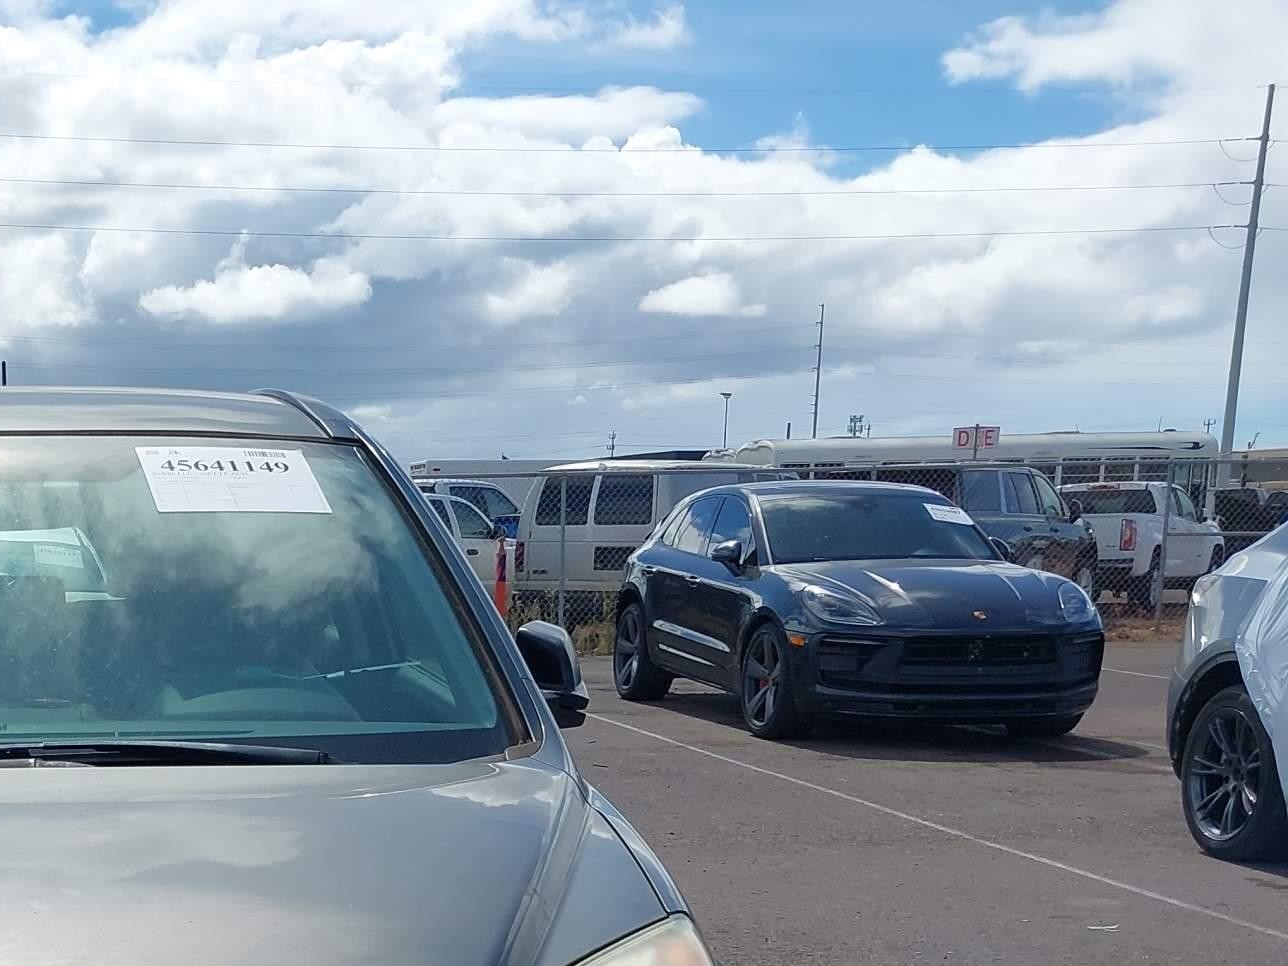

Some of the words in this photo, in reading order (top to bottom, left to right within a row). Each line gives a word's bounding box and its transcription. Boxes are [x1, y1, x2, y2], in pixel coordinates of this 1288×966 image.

[958, 430, 970, 447] D
[984, 430, 995, 446] E
[160, 459, 290, 473] 45641149
